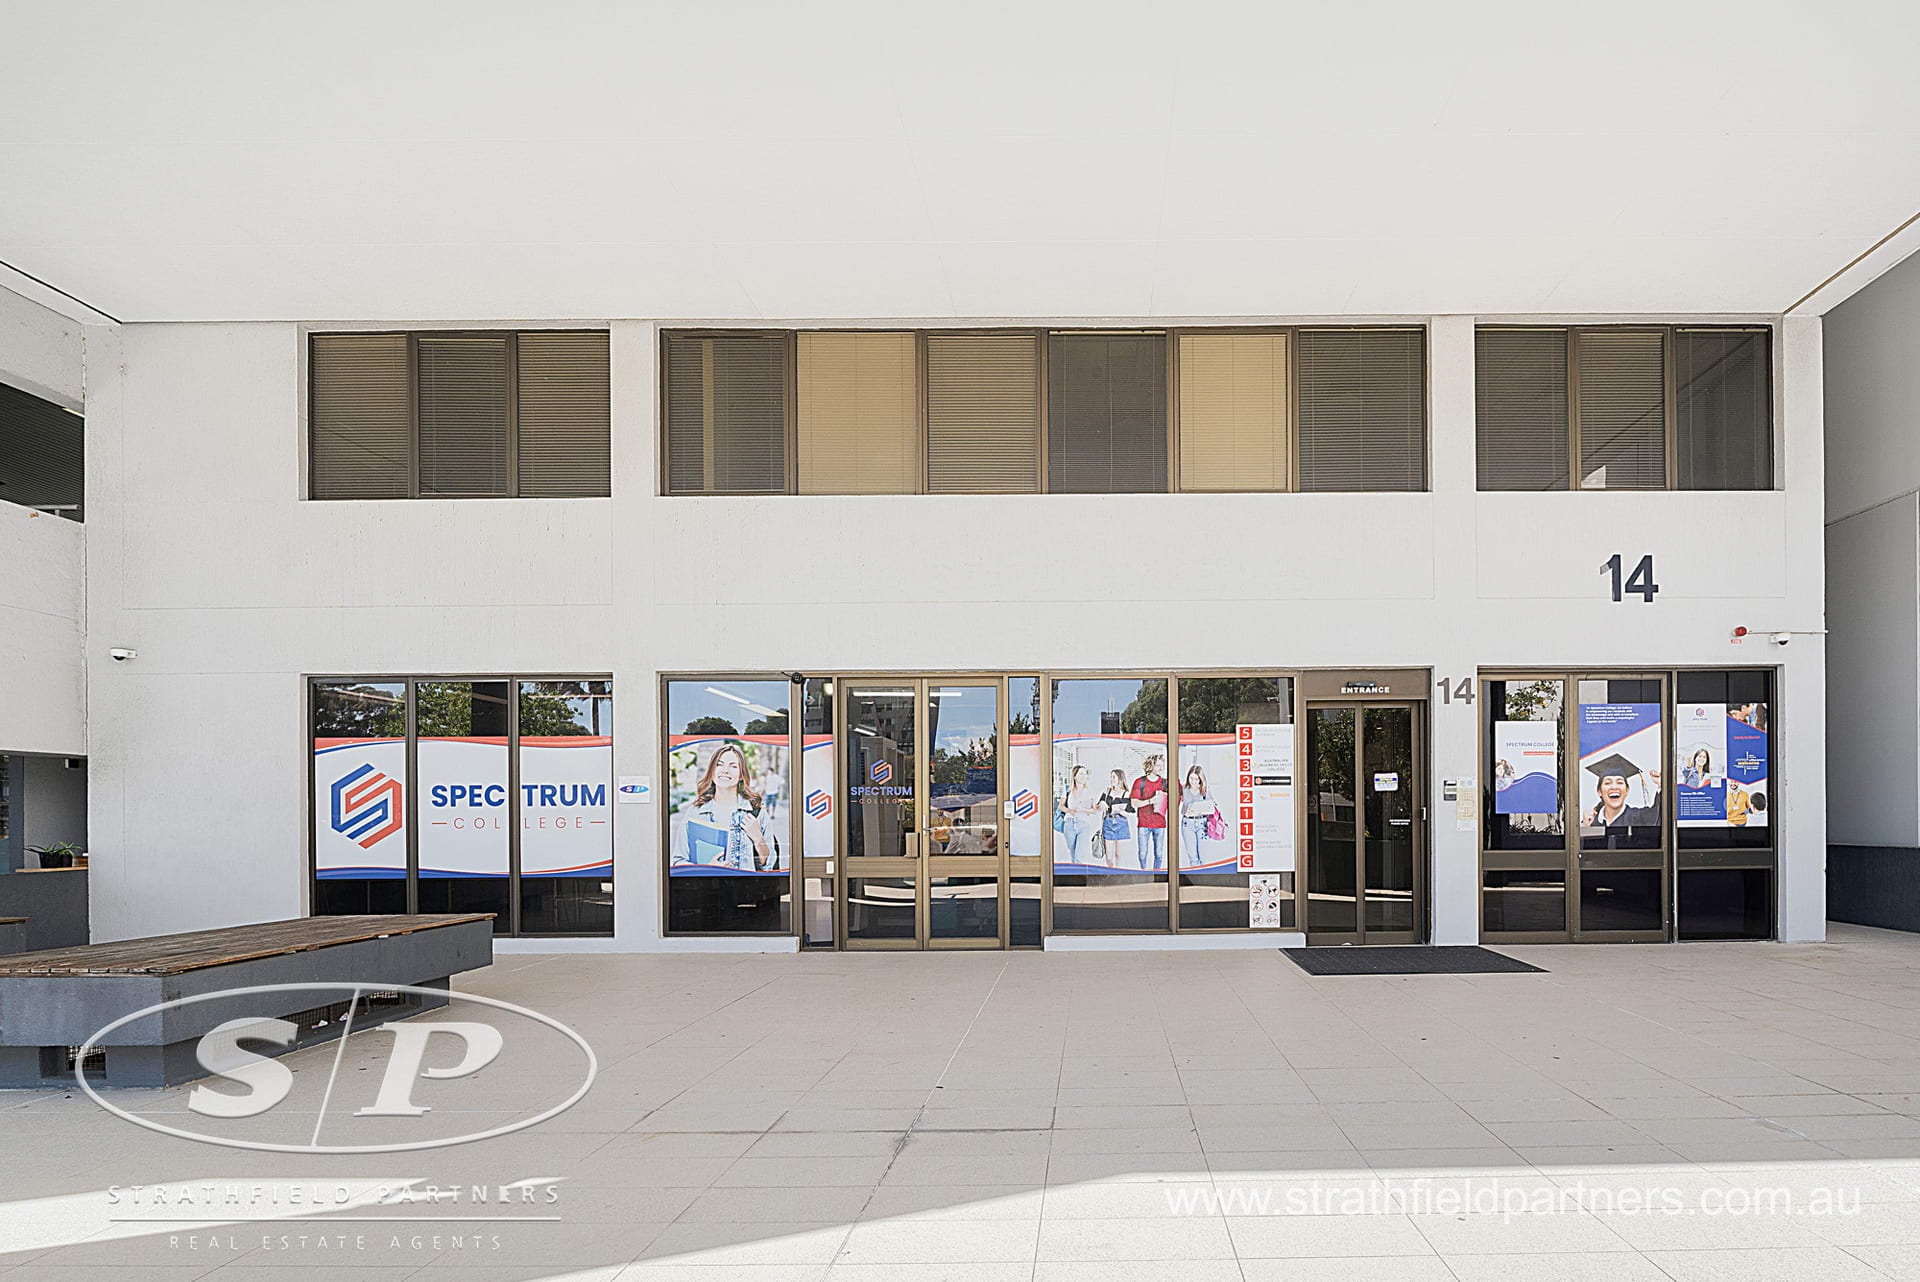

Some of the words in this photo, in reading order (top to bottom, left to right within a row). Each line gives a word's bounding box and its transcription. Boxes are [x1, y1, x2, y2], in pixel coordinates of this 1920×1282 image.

[1599, 553, 1660, 603] 14
[1340, 686, 1390, 694] ENTRANCE
[1437, 677, 1476, 705] 14
[1241, 727, 1250, 739] 5
[1241, 744, 1251, 755] 4
[1242, 760, 1250, 771] 3
[850, 786, 913, 796] SPECTRUM
